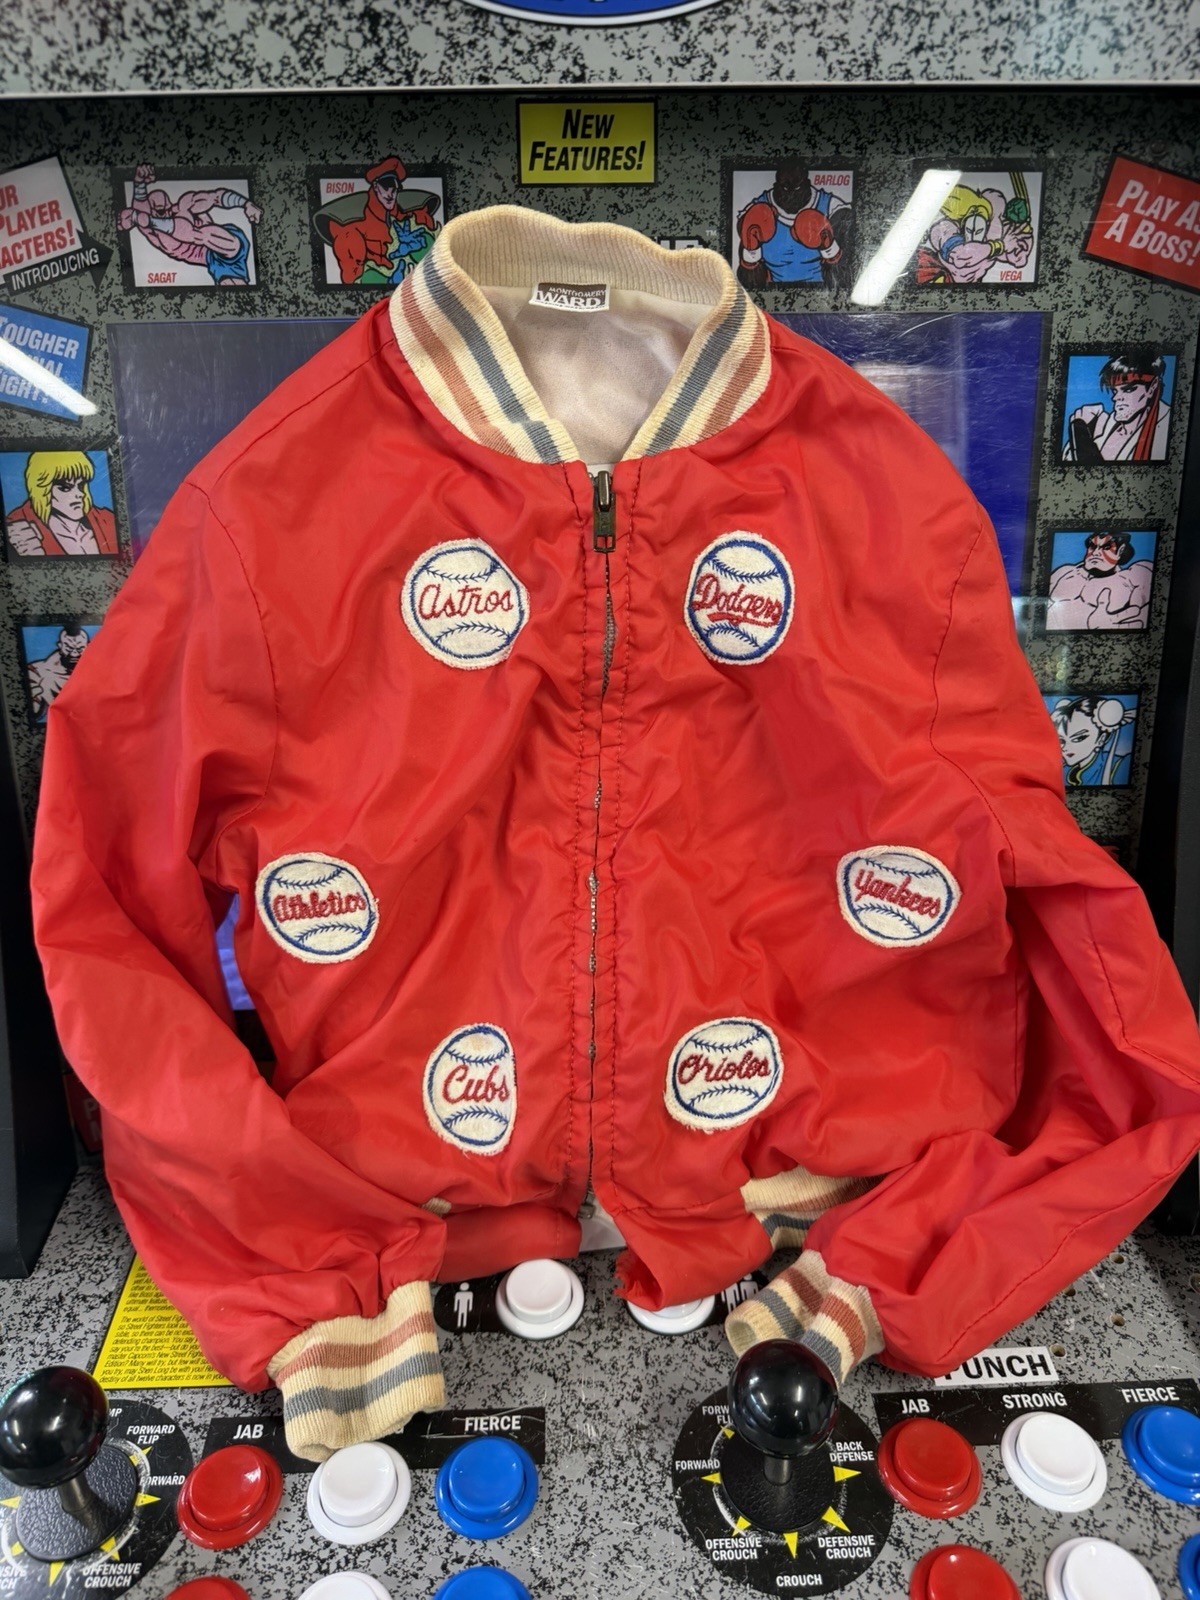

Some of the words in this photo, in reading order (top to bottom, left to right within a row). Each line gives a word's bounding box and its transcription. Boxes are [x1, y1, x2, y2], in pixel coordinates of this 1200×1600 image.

[561, 108, 615, 139] NEW
[528, 140, 646, 172] FEATURES!
[325, 181, 356, 194] BISON
[813, 174, 851, 187] BARLOG
[1116, 180, 1180, 222] PLAY
[1103, 212, 1129, 243] A
[0, 218, 76, 270] ACTERS!
[11, 247, 100, 291] INTRODUCING
[1000, 270, 1023, 281] VEGA
[147, 272, 178, 284] SAGAT
[537, 290, 602, 308] WARD
[549, 287, 606, 298] MONTGOMERY
[418, 583, 514, 620] Astros
[690, 573, 783, 626] Dodgers
[854, 868, 942, 919] Yankees
[272, 890, 366, 923] Athletics
[677, 1050, 772, 1085] Orioles
[442, 1065, 510, 1105] Cubs
[1001, 1392, 1068, 1409] STRONG
[1120, 1386, 1180, 1403] FIERCE
[702, 1405, 730, 1416] FORW
[902, 1399, 931, 1414] JAB
[126, 1425, 175, 1435] FORWARD
[464, 1415, 521, 1432] FIERCE
[232, 1424, 265, 1439] JAB
[137, 1435, 160, 1445] FLIP
[835, 1441, 864, 1451] BACK
[829, 1451, 875, 1462] DEFENSE
[675, 1459, 721, 1470] FORWARD
[139, 1475, 186, 1486] FORWARD
[705, 1537, 763, 1550] OFFENSIVE
[817, 1535, 876, 1548] DEFENSIVE
[712, 1549, 758, 1561] CROUCH
[825, 1547, 872, 1559] CROUCH
[82, 1562, 142, 1577] OFFENSIVE
[84, 1576, 133, 1589] CROUCH
[776, 1574, 823, 1587] CROUCH
